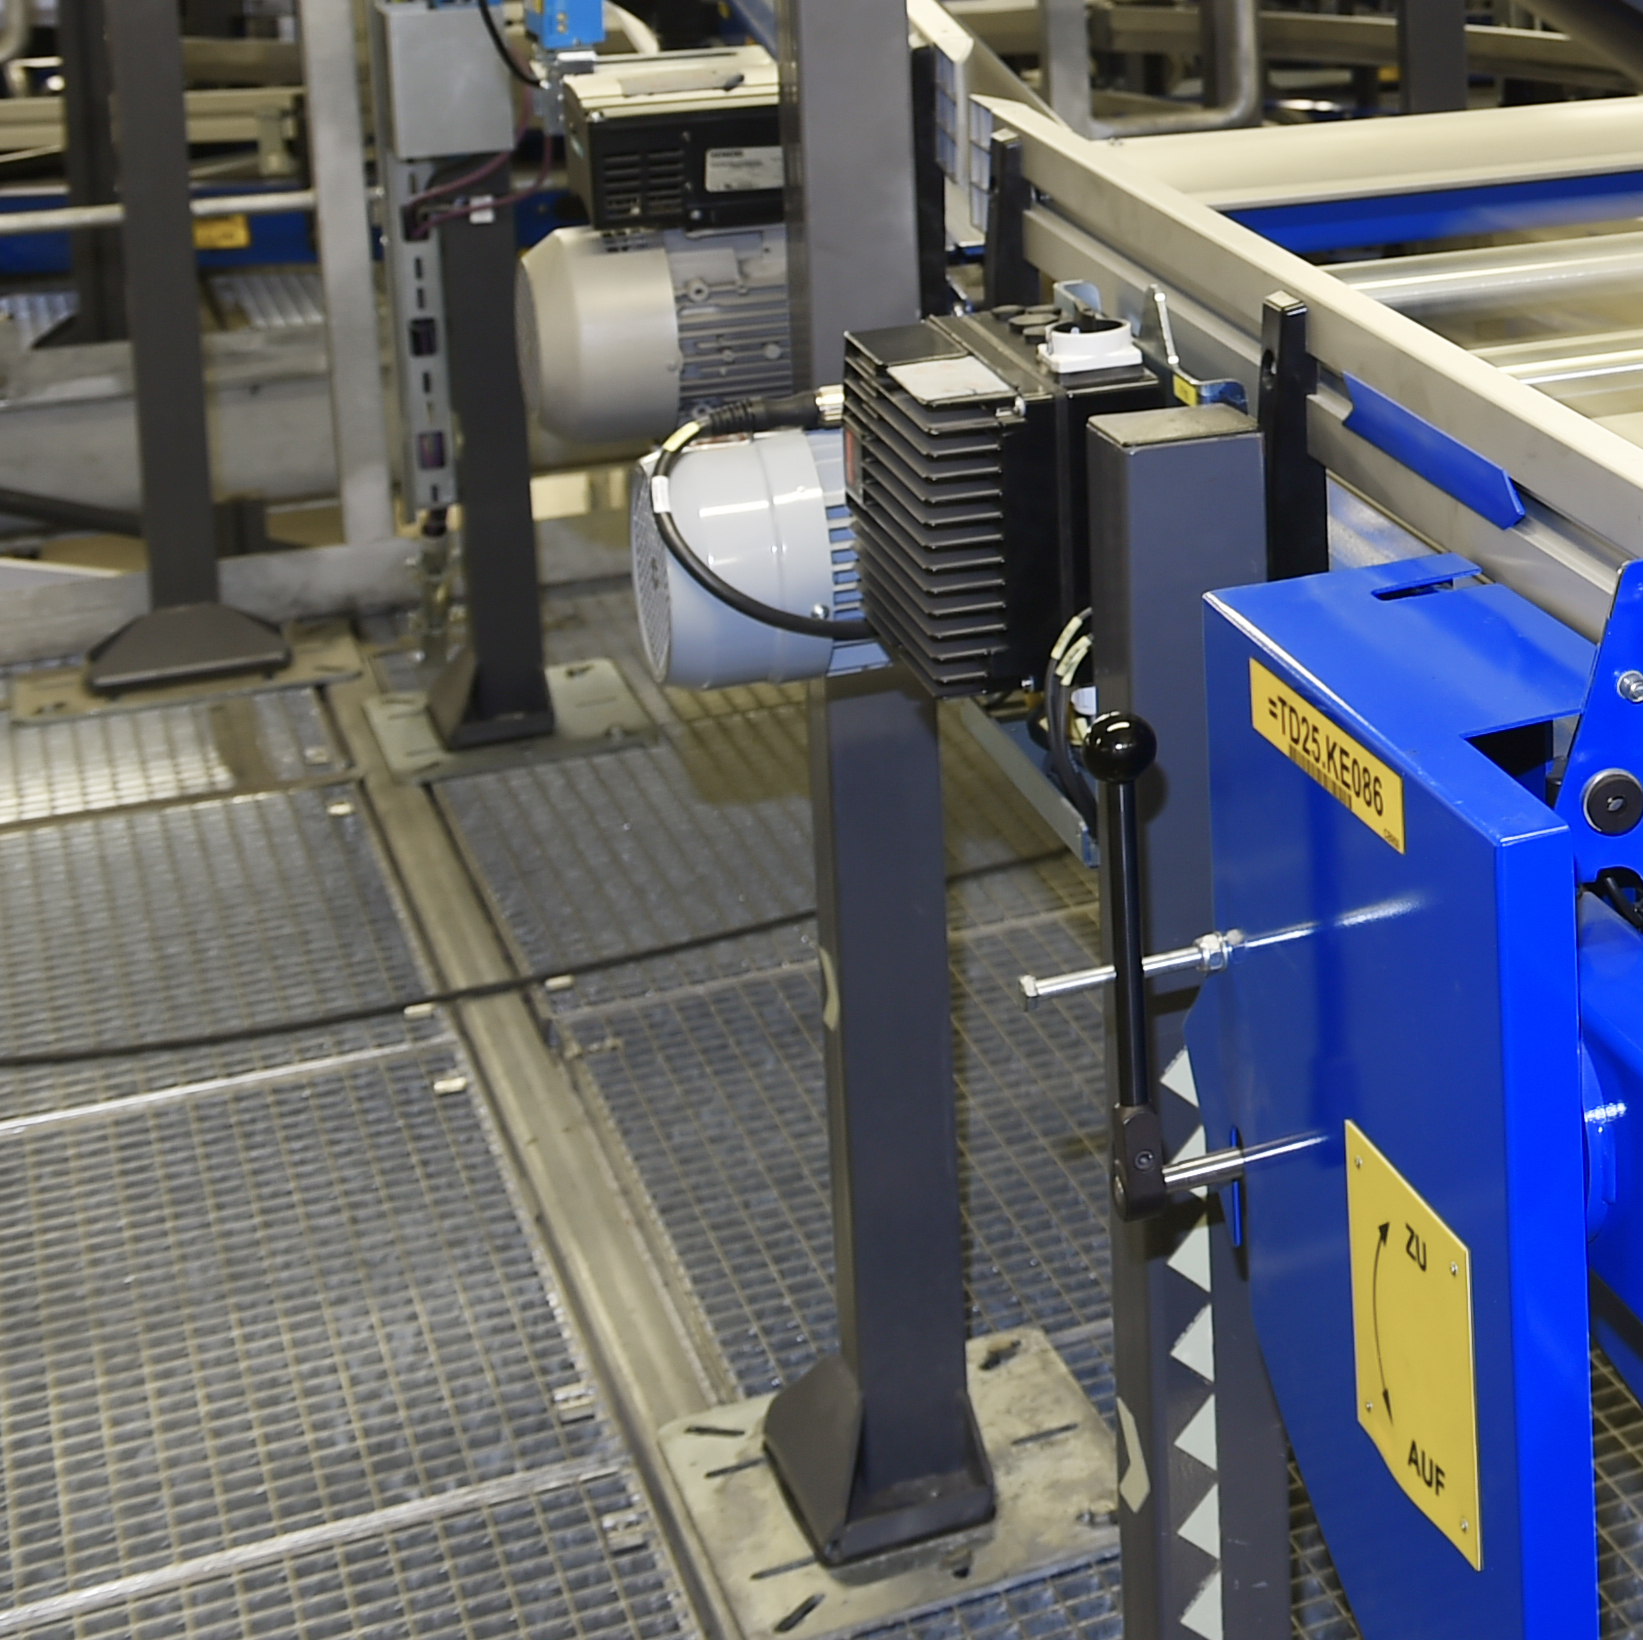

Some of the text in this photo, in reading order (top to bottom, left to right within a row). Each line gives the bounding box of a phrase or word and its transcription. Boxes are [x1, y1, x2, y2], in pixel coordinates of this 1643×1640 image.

[1268, 695, 1384, 817] =TD25.KE086
[1405, 1222, 1427, 1272] ZU
[1407, 1439, 1446, 1496] AUF
